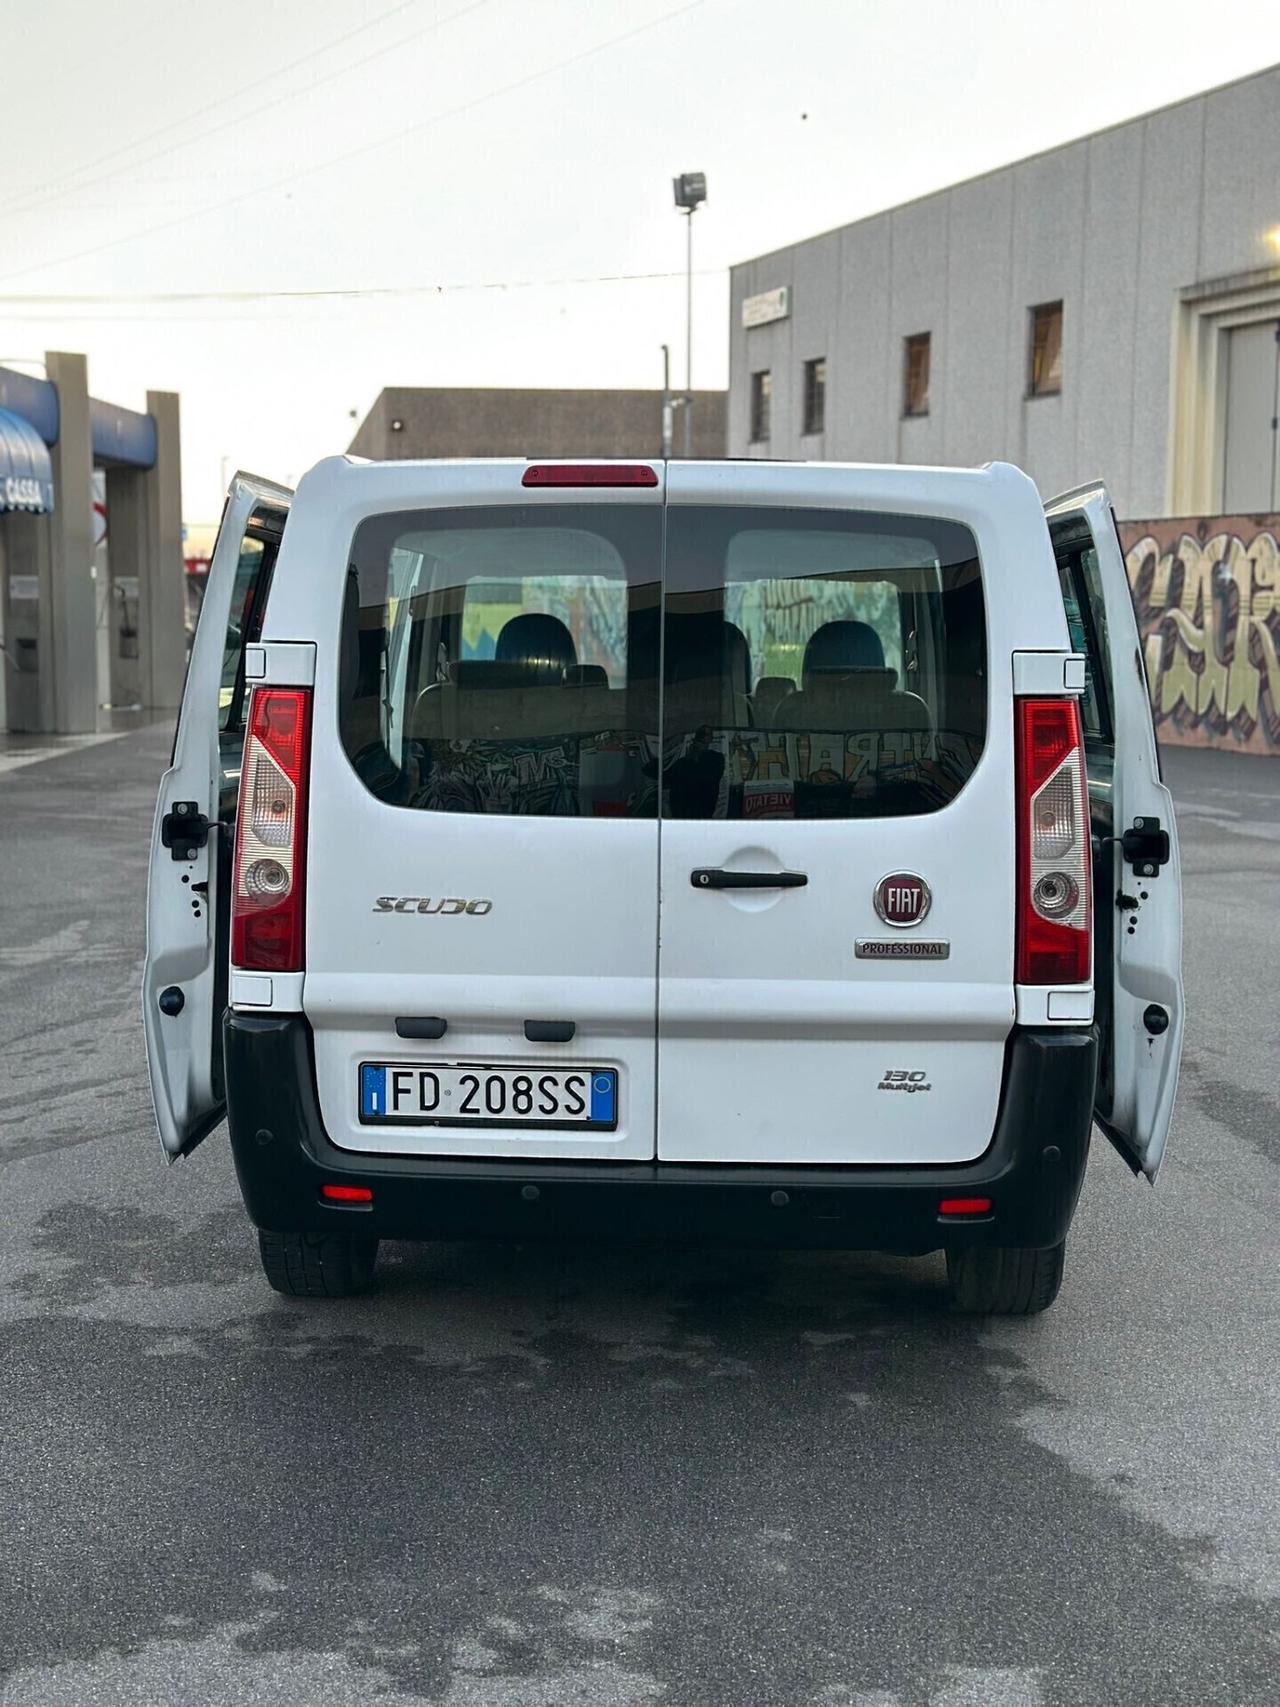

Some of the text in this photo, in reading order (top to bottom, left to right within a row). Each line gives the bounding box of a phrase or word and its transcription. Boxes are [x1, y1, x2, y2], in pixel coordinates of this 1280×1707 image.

[372, 896, 493, 915] SCUDO
[887, 887, 921, 913] FIAT
[862, 942, 944, 955] PROFESSIONAL
[883, 1070, 927, 1082] 130
[458, 1074, 587, 1116] 208SS
